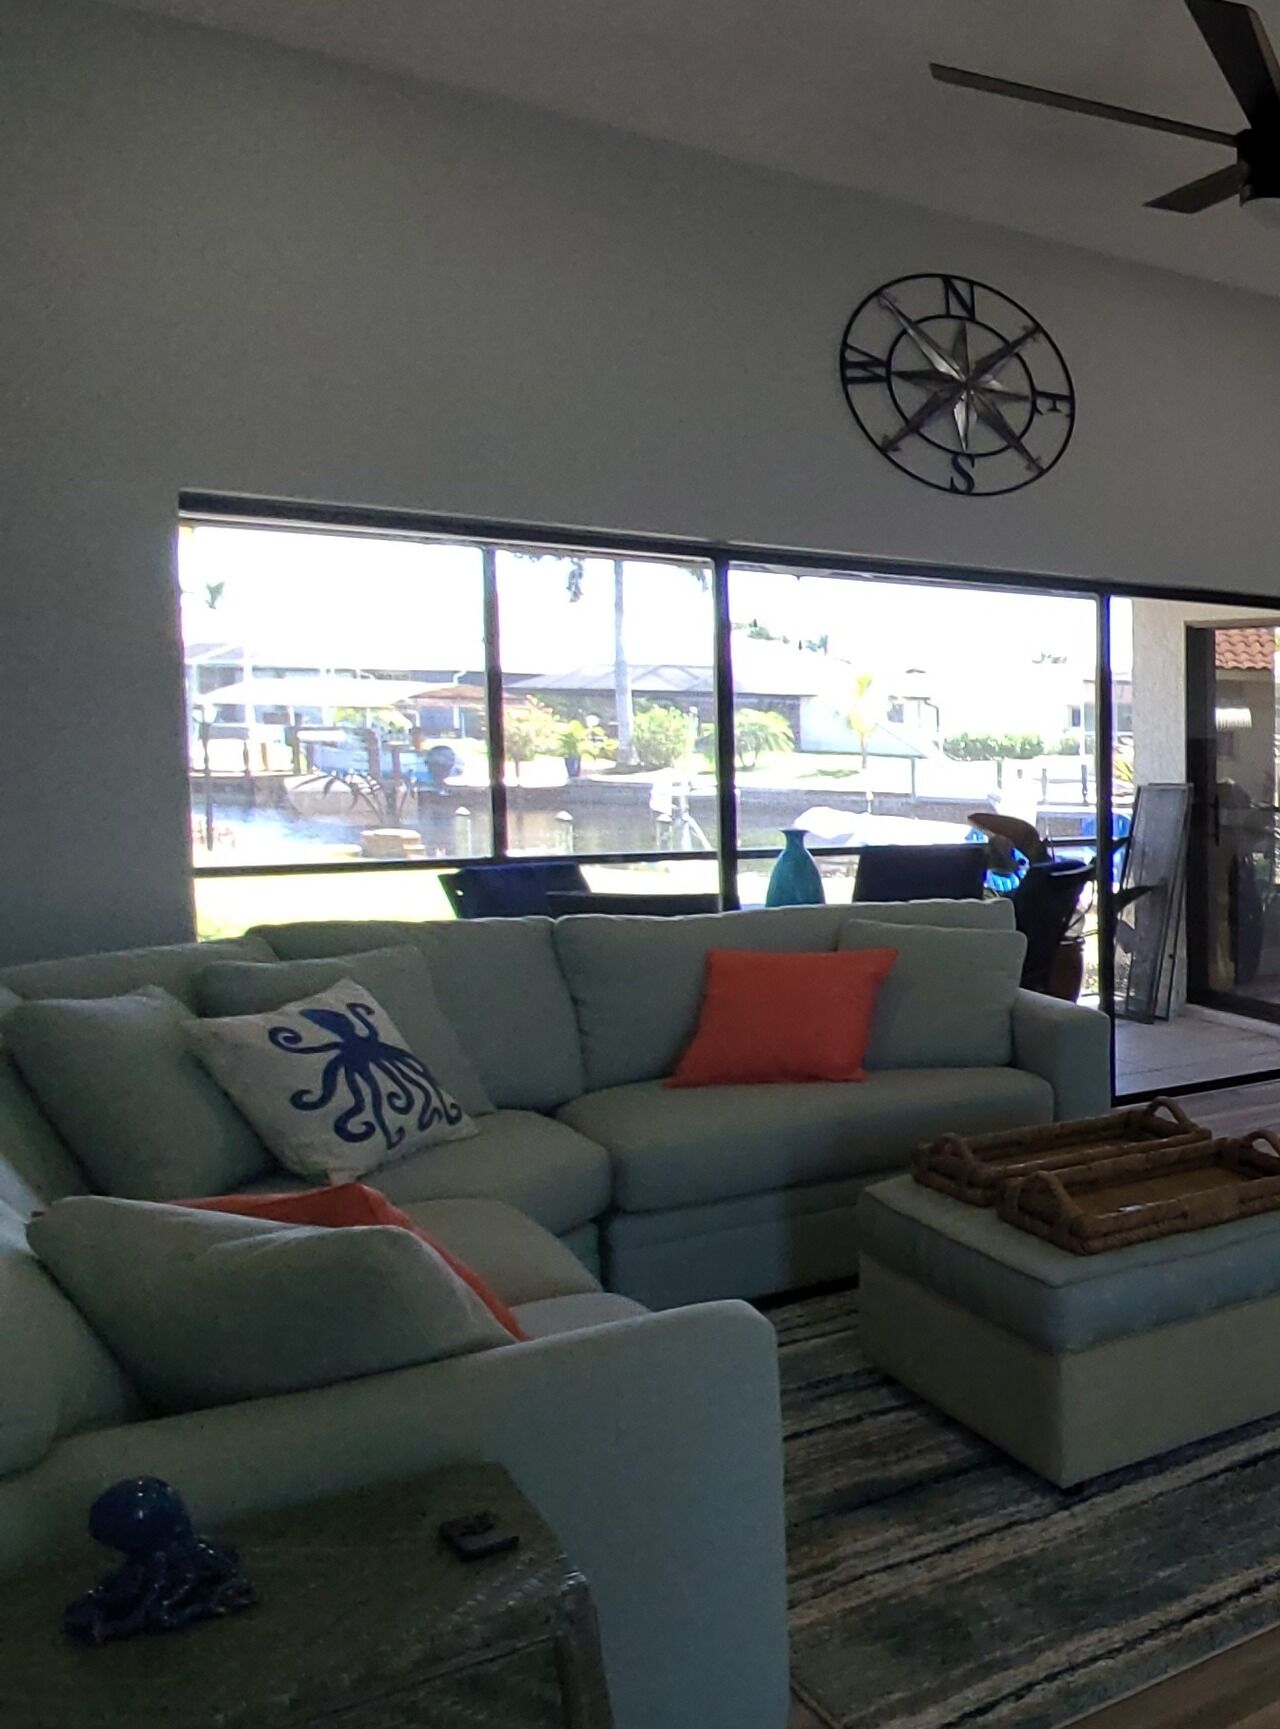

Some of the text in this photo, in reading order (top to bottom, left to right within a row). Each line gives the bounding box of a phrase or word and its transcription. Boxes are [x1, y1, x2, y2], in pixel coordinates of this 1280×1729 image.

[943, 276, 976, 321] N
[842, 343, 889, 384] W
[1032, 390, 1075, 417] E
[949, 454, 975, 494] S
